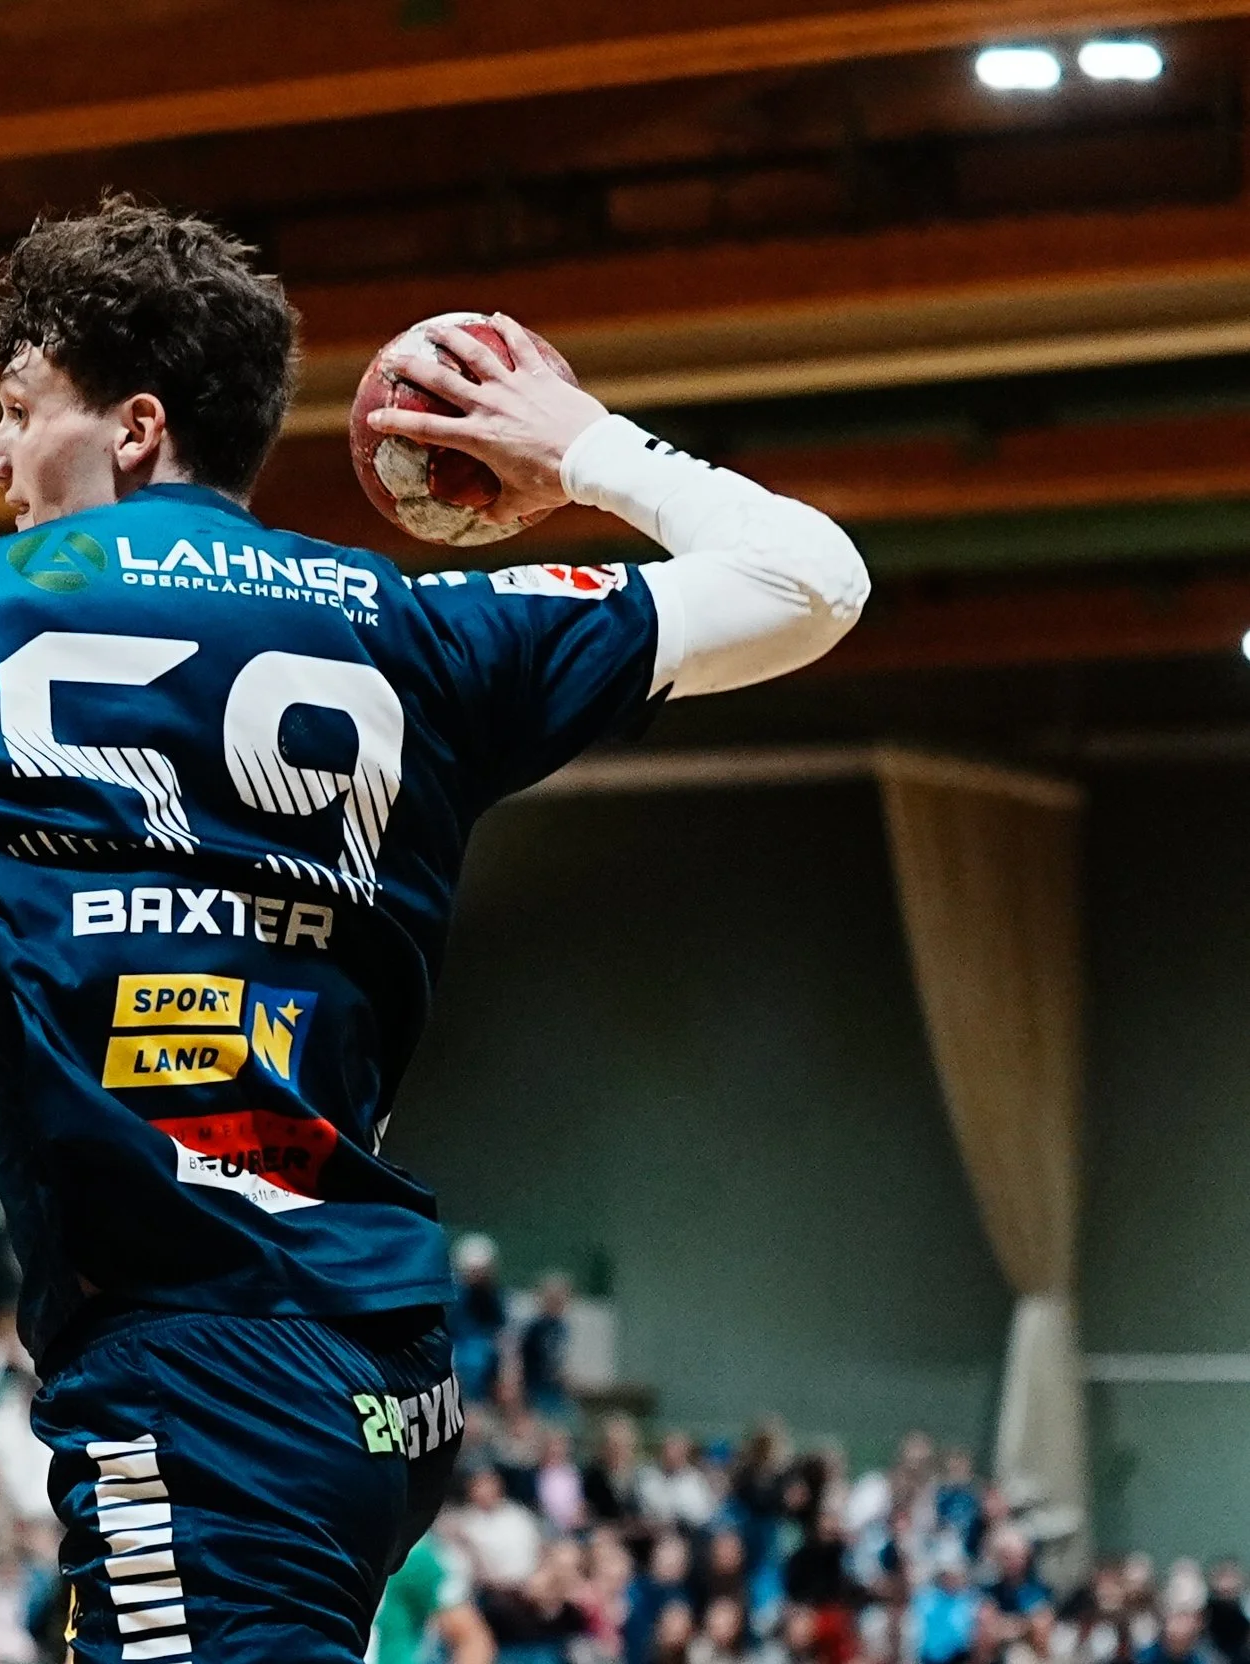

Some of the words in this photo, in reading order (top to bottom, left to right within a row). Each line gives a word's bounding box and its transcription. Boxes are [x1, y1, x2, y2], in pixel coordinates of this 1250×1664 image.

[116, 537, 379, 610] LAHNER
[122, 572, 379, 627] OBERFLÄCHENTECNIK
[72, 887, 334, 950] BAXTER
[133, 988, 230, 1013] SPORT
[133, 1047, 220, 1074] LAND
